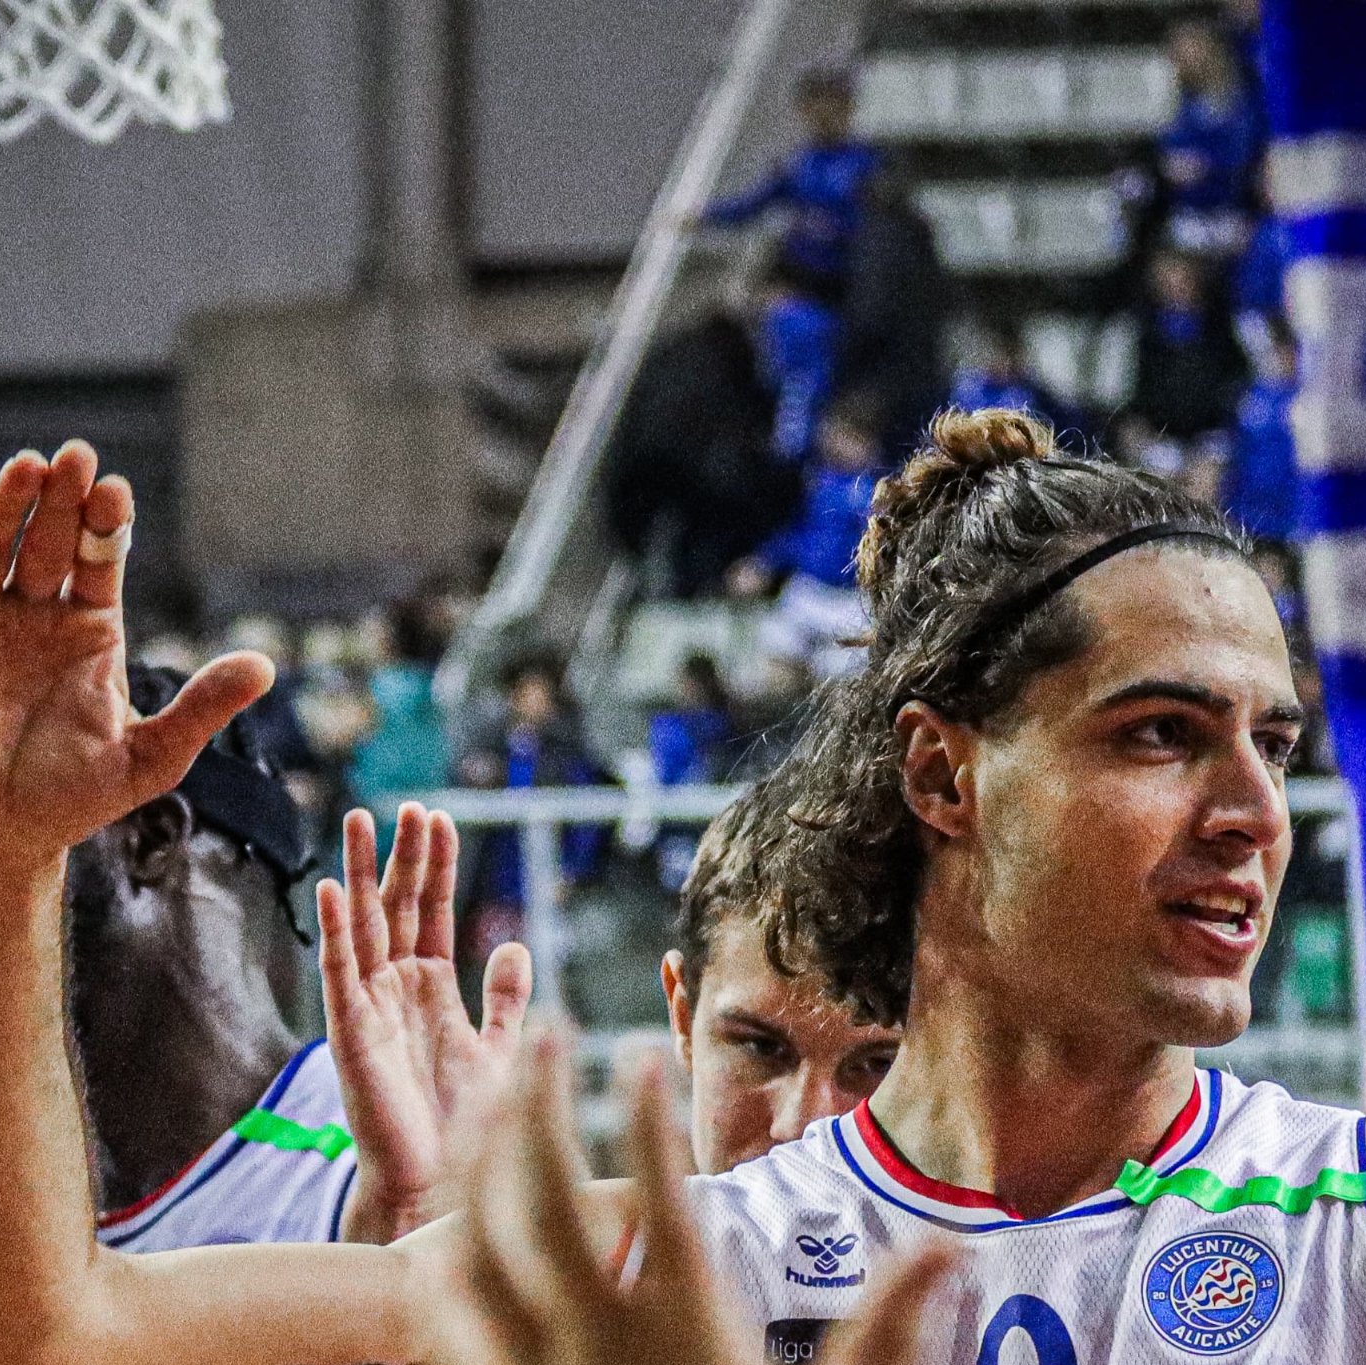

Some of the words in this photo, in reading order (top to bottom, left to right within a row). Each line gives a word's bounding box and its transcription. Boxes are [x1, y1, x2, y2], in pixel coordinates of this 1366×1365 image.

[1160, 1239, 1261, 1273] LUCENTUM
[786, 1266, 866, 1288] hummel
[1171, 1315, 1262, 1347] ALICANTE
